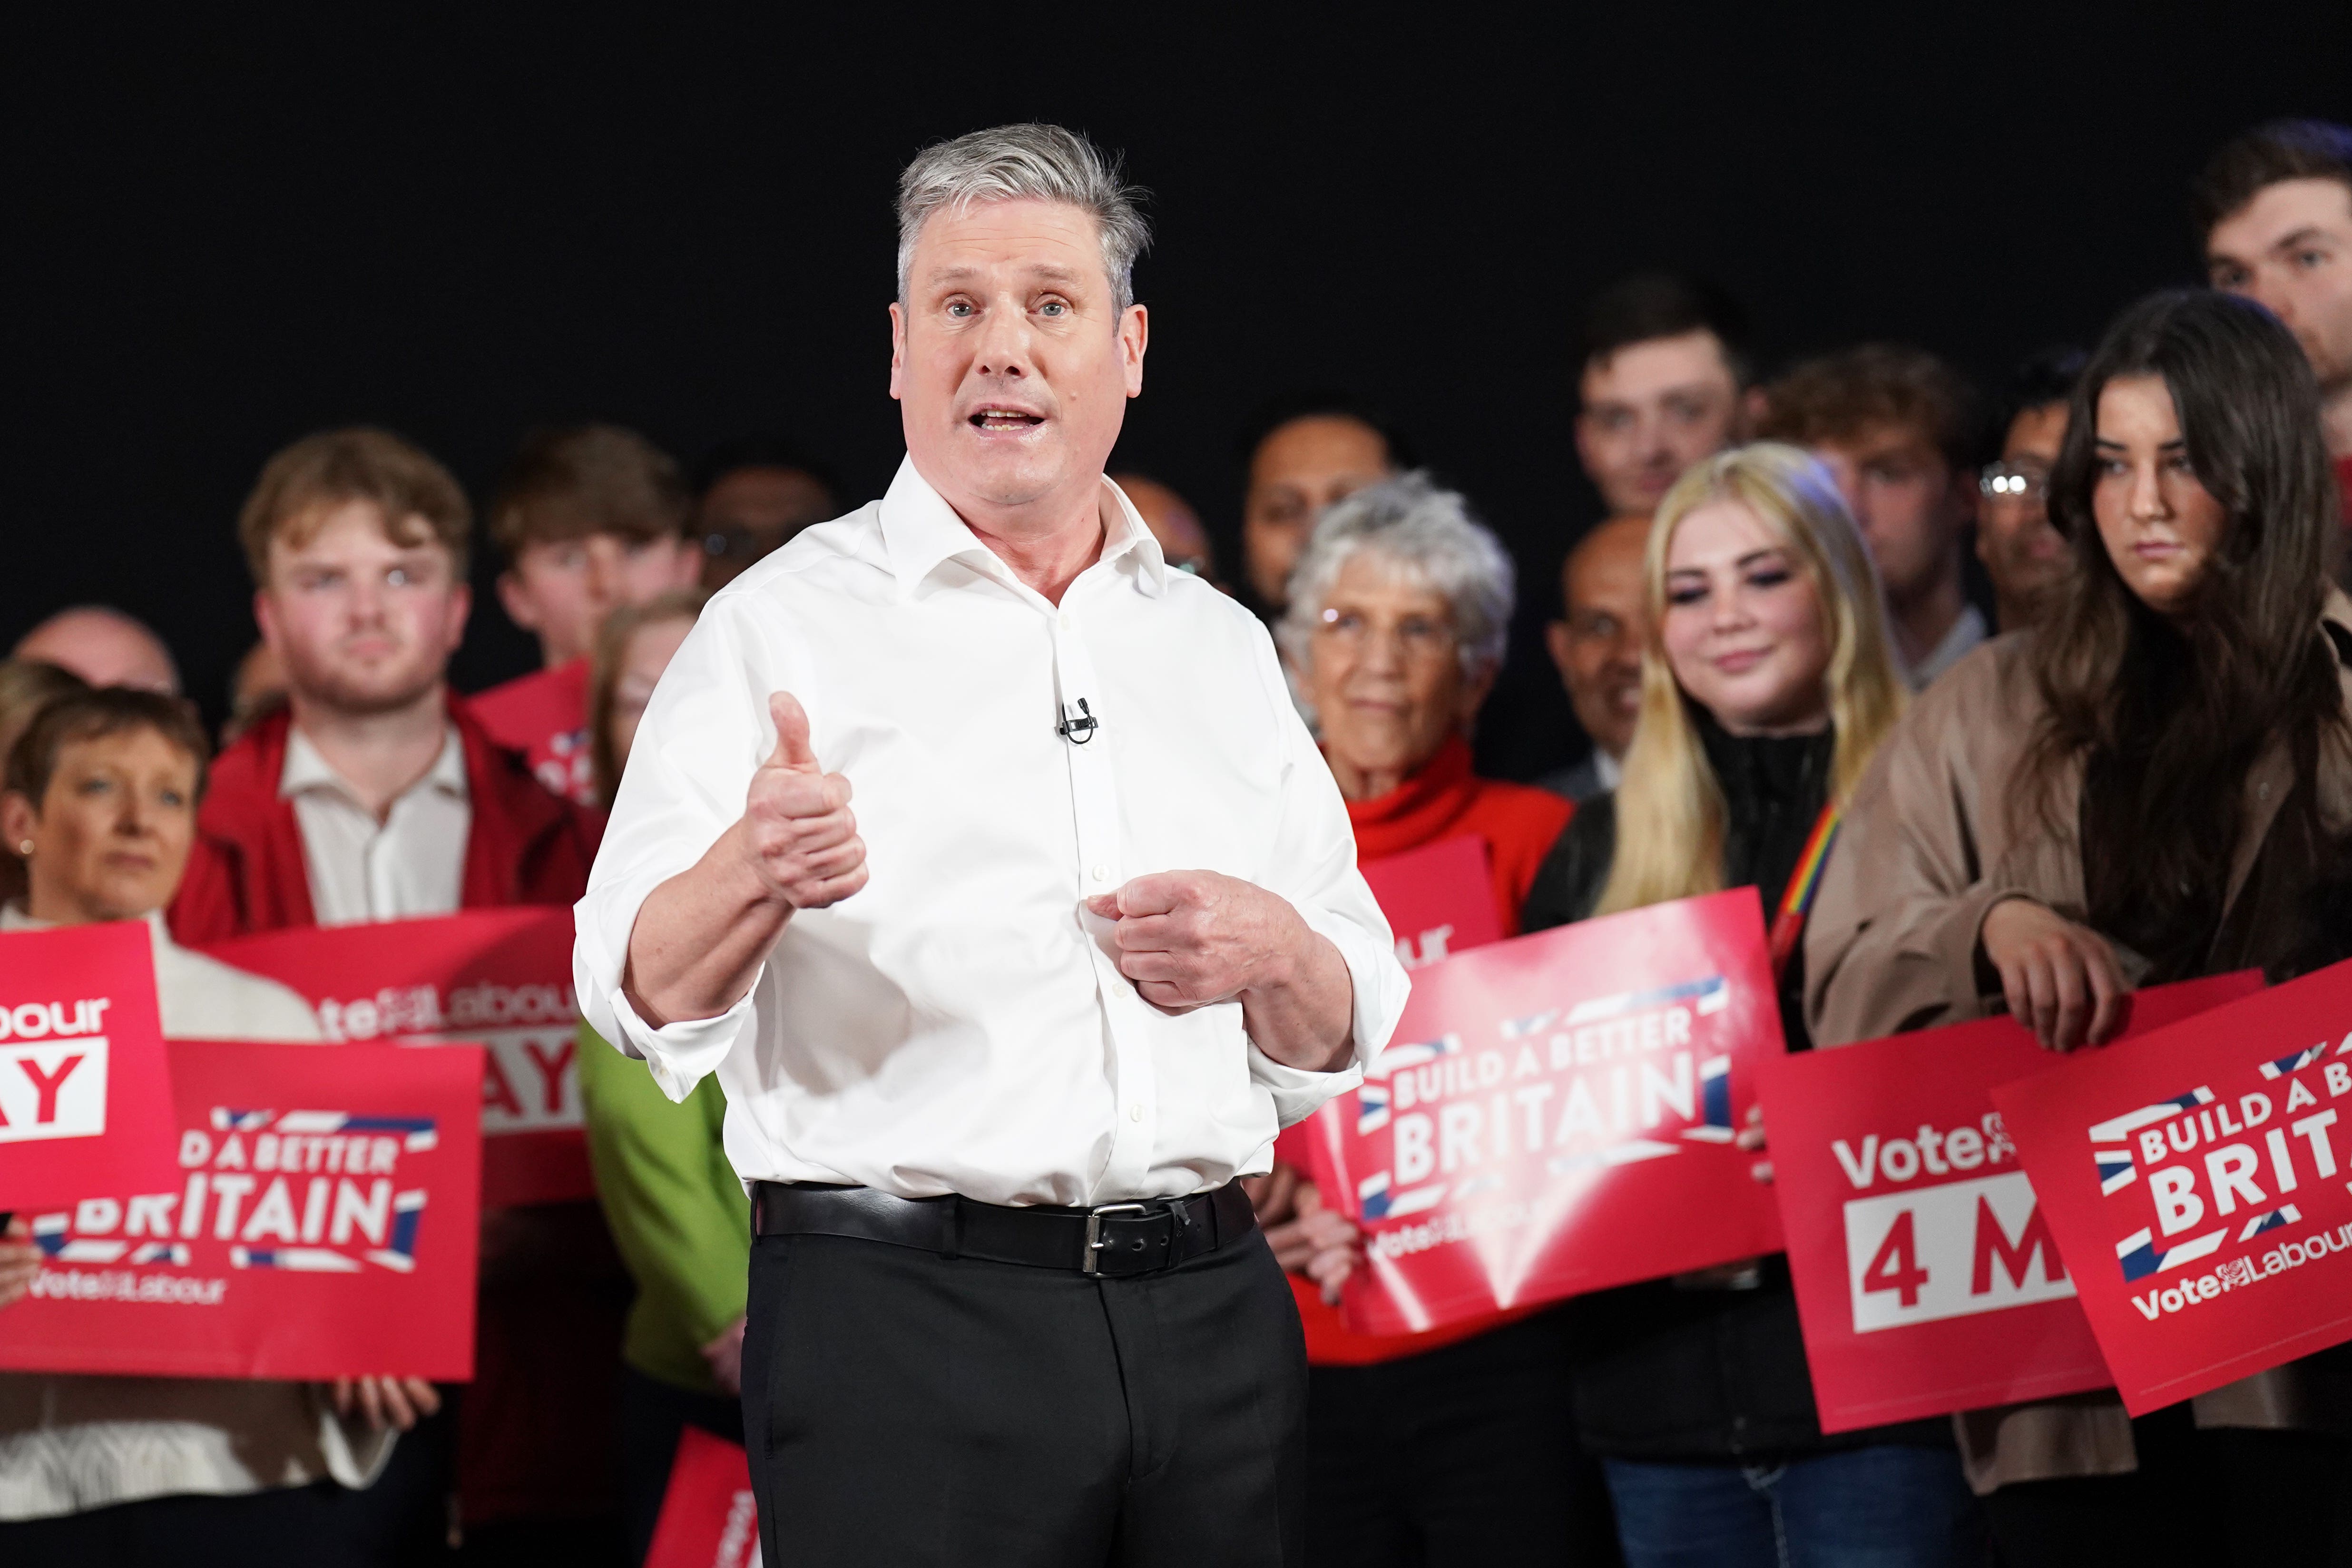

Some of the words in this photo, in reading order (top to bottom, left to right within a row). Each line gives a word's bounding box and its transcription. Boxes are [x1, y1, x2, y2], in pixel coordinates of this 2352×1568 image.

[1394, 1049, 1505, 1109] BUILD
[1513, 1042, 1541, 1080] A
[1548, 1006, 1692, 1071] BETTER
[214, 1132, 246, 1170] A
[252, 1132, 400, 1176] BETTER
[1394, 1051, 1697, 1186] BRITAIN
[1830, 1123, 1985, 1189] Vote
[2138, 1092, 2273, 1166] BUILD
[2285, 1077, 2318, 1114] A
[74, 1171, 392, 1245] BRITAIN
[2147, 1107, 2352, 1238] BRIT
[1862, 1207, 1930, 1310] 4
[2131, 1274, 2222, 1321] Vote
